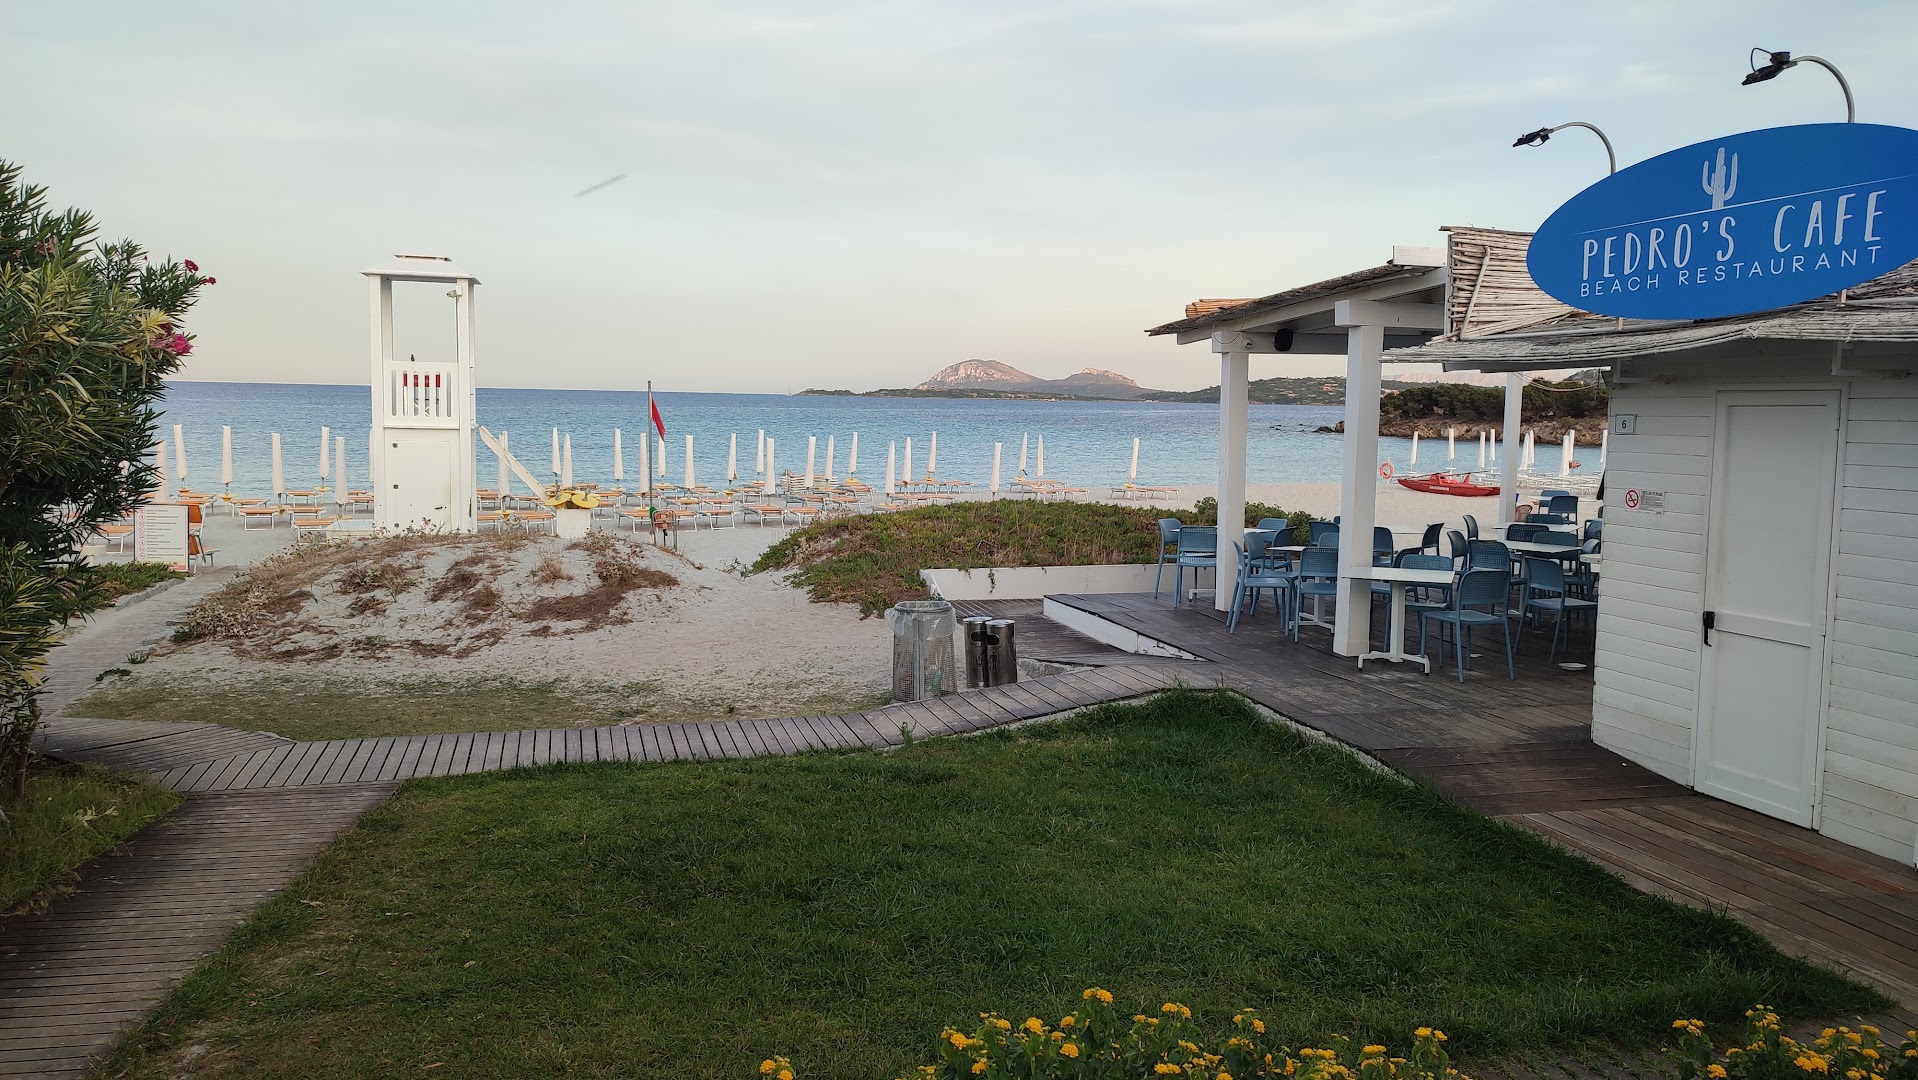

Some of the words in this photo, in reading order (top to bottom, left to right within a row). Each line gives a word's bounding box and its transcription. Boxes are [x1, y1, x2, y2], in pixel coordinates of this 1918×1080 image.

[1581, 216, 1736, 281] PEDRO'S
[1773, 190, 1887, 253] CAFE
[1580, 273, 1660, 298] BEACH
[1678, 246, 1882, 286] RESTAURANT
[1621, 420, 1627, 429] 6
